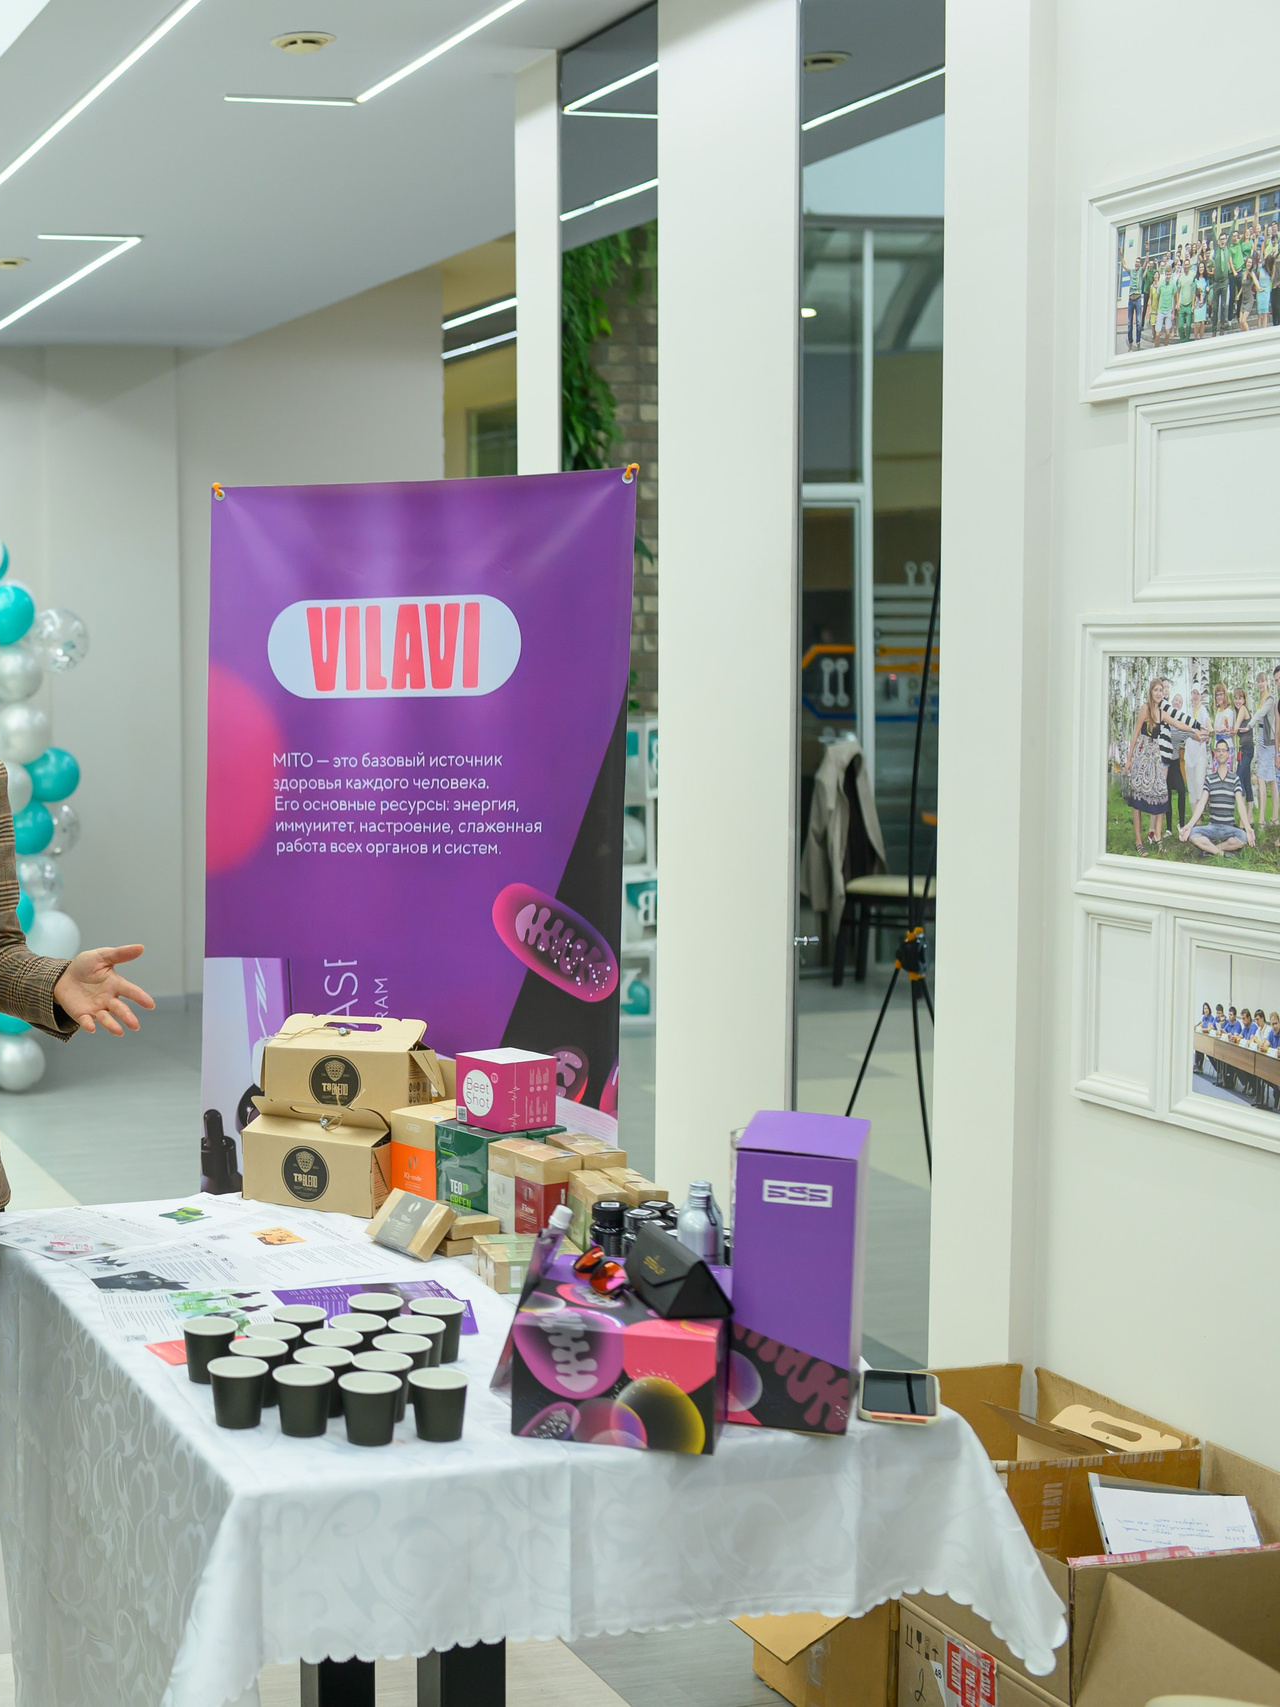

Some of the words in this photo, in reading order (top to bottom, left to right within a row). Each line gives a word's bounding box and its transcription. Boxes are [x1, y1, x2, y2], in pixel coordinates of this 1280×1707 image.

[305, 602, 481, 692] VILAVI
[272, 752, 314, 768] MITO
[333, 756, 358, 768] это
[361, 751, 425, 768] базовый
[429, 755, 503, 767] источник
[273, 778, 341, 793] здоровья
[345, 778, 409, 791] каждого
[412, 777, 489, 789] человека.
[275, 796, 300, 811] Его
[302, 799, 377, 811] основные
[380, 799, 450, 815] ресурсы:
[453, 799, 520, 815] энергия,
[275, 821, 357, 836] иммунитет,
[359, 821, 454, 836] настроение,
[458, 821, 542, 833] слаженная
[276, 837, 327, 855] работа
[330, 841, 363, 853] всех
[366, 842, 428, 857] органов
[432, 843, 441, 854] и
[444, 843, 502, 855] систем.
[467, 1077, 489, 1095] Beet
[466, 1091, 490, 1109] Shot
[450, 1179, 463, 1195] TEO
[1041, 1482, 1063, 1531] VILAVI
